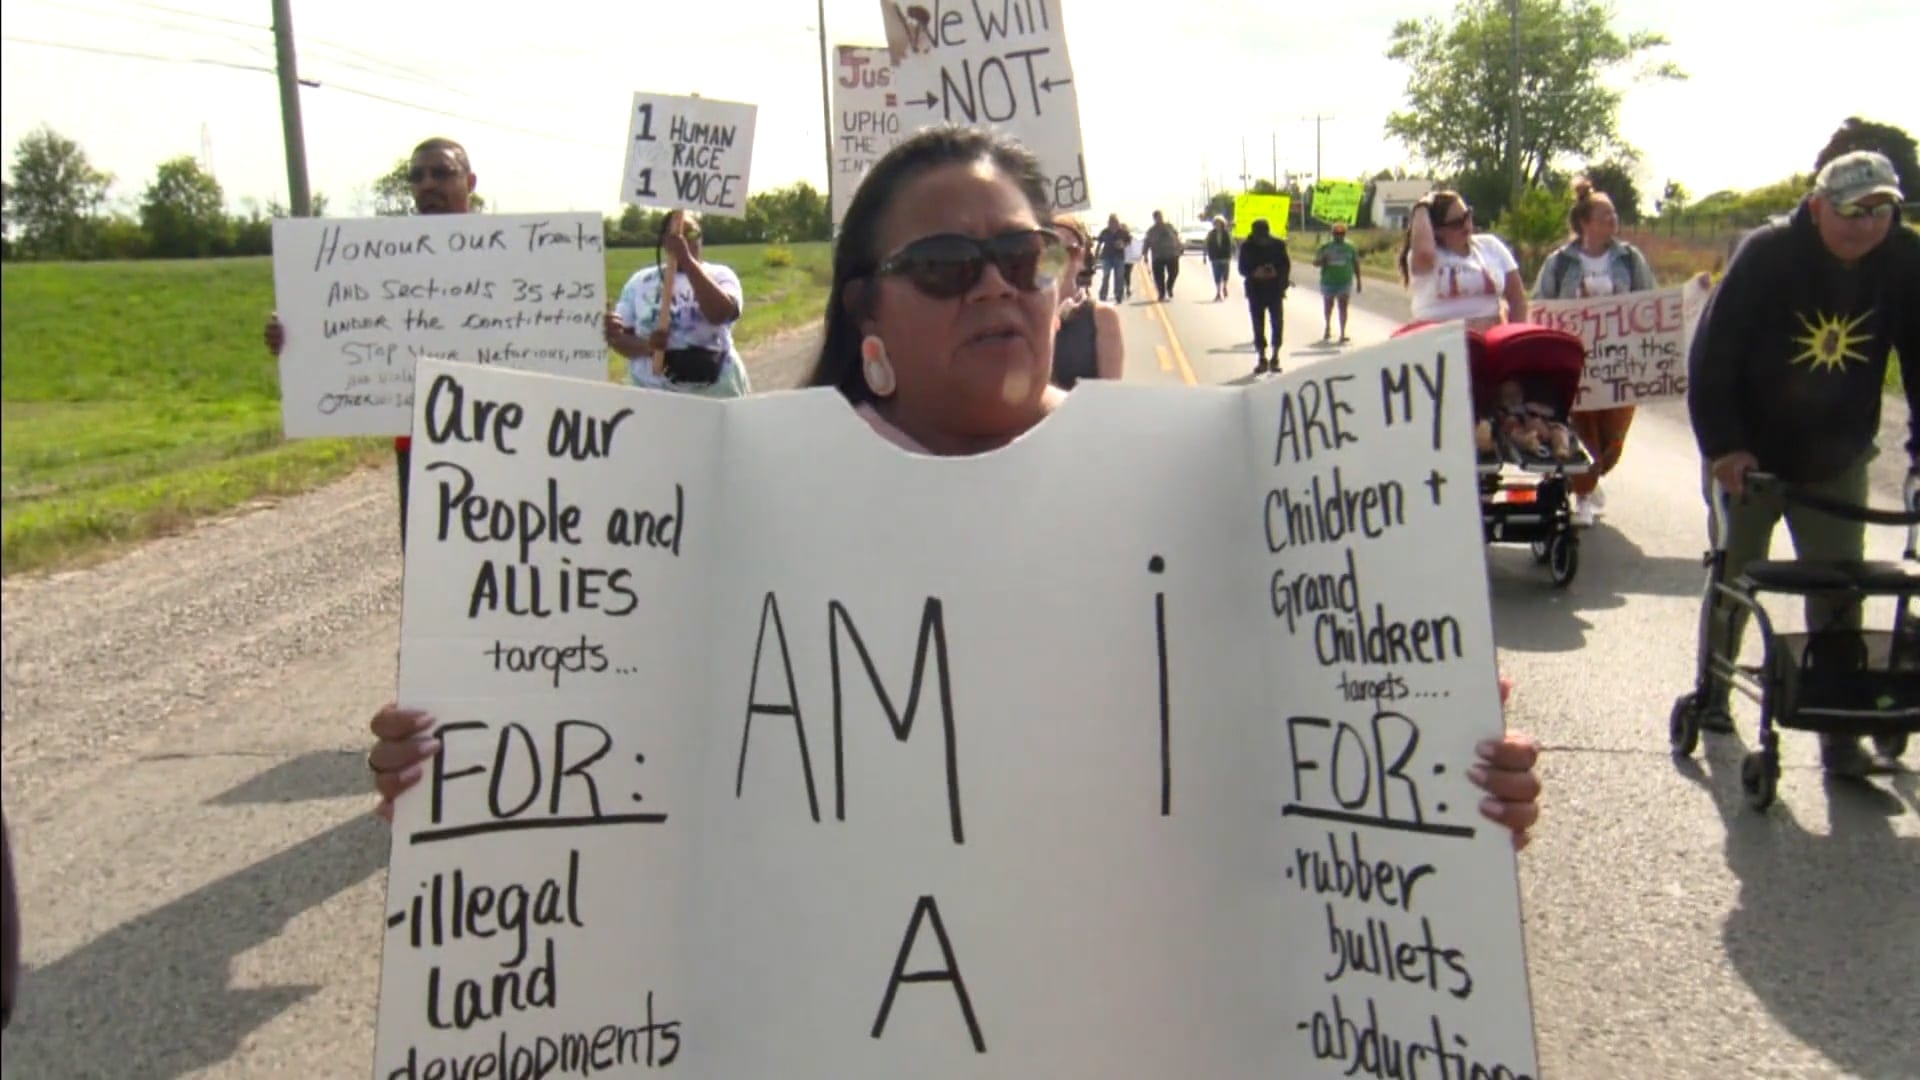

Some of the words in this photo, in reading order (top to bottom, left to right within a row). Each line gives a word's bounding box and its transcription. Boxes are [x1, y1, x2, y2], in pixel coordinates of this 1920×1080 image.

[894, 0, 966, 53] We
[972, 0, 1049, 43] Will
[941, 47, 1050, 123] NOT
[635, 103, 656, 141] 1
[670, 115, 736, 148] HUMAN
[840, 134, 877, 154] THE
[843, 110, 899, 135] UPHO
[672, 143, 725, 170] RACE
[635, 168, 657, 197] 1
[673, 170, 741, 208] VOICE
[449, 229, 507, 251] OUR
[327, 281, 370, 307] AND
[512, 278, 543, 302] 35
[404, 307, 446, 332] the
[547, 408, 635, 460] our
[1274, 375, 1359, 466] ARE
[1381, 352, 1446, 450] MY
[425, 461, 582, 565] People
[607, 483, 685, 557] and
[1264, 466, 1405, 553] Children
[736, 591, 964, 845] AM
[871, 895, 987, 1054] A
[1324, 903, 1473, 1000] bullets
[387, 989, 682, 1080] developments
